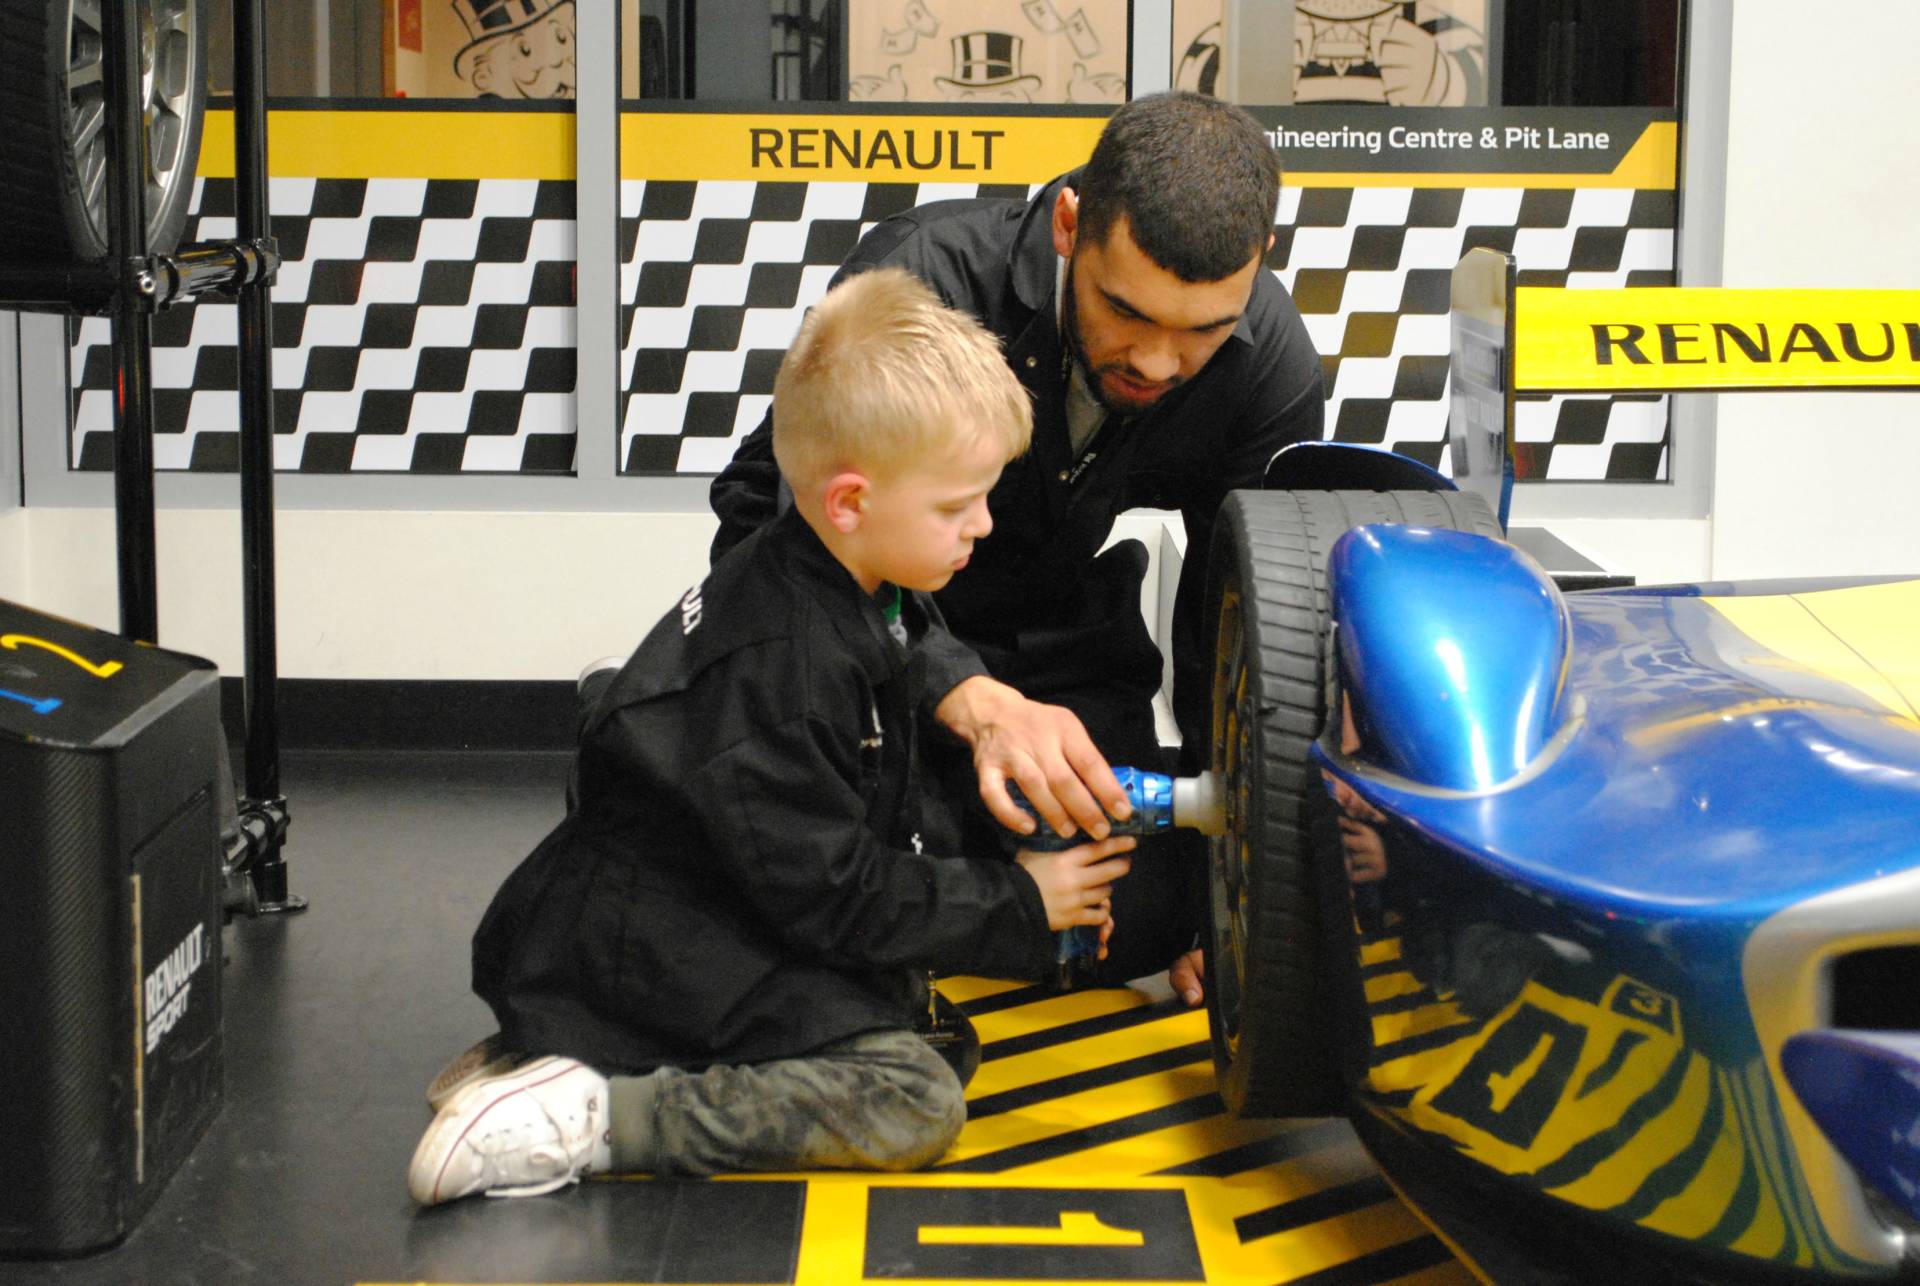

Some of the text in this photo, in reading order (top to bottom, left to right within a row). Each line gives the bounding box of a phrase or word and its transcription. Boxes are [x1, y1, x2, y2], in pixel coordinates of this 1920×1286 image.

[749, 128, 1005, 170] RENAULT
[1263, 125, 1610, 154] ineering Centre & Pit Lane
[145, 922, 204, 1022] RENAULT
[146, 981, 191, 1056] SPORT
[917, 1210, 1145, 1246] 1
